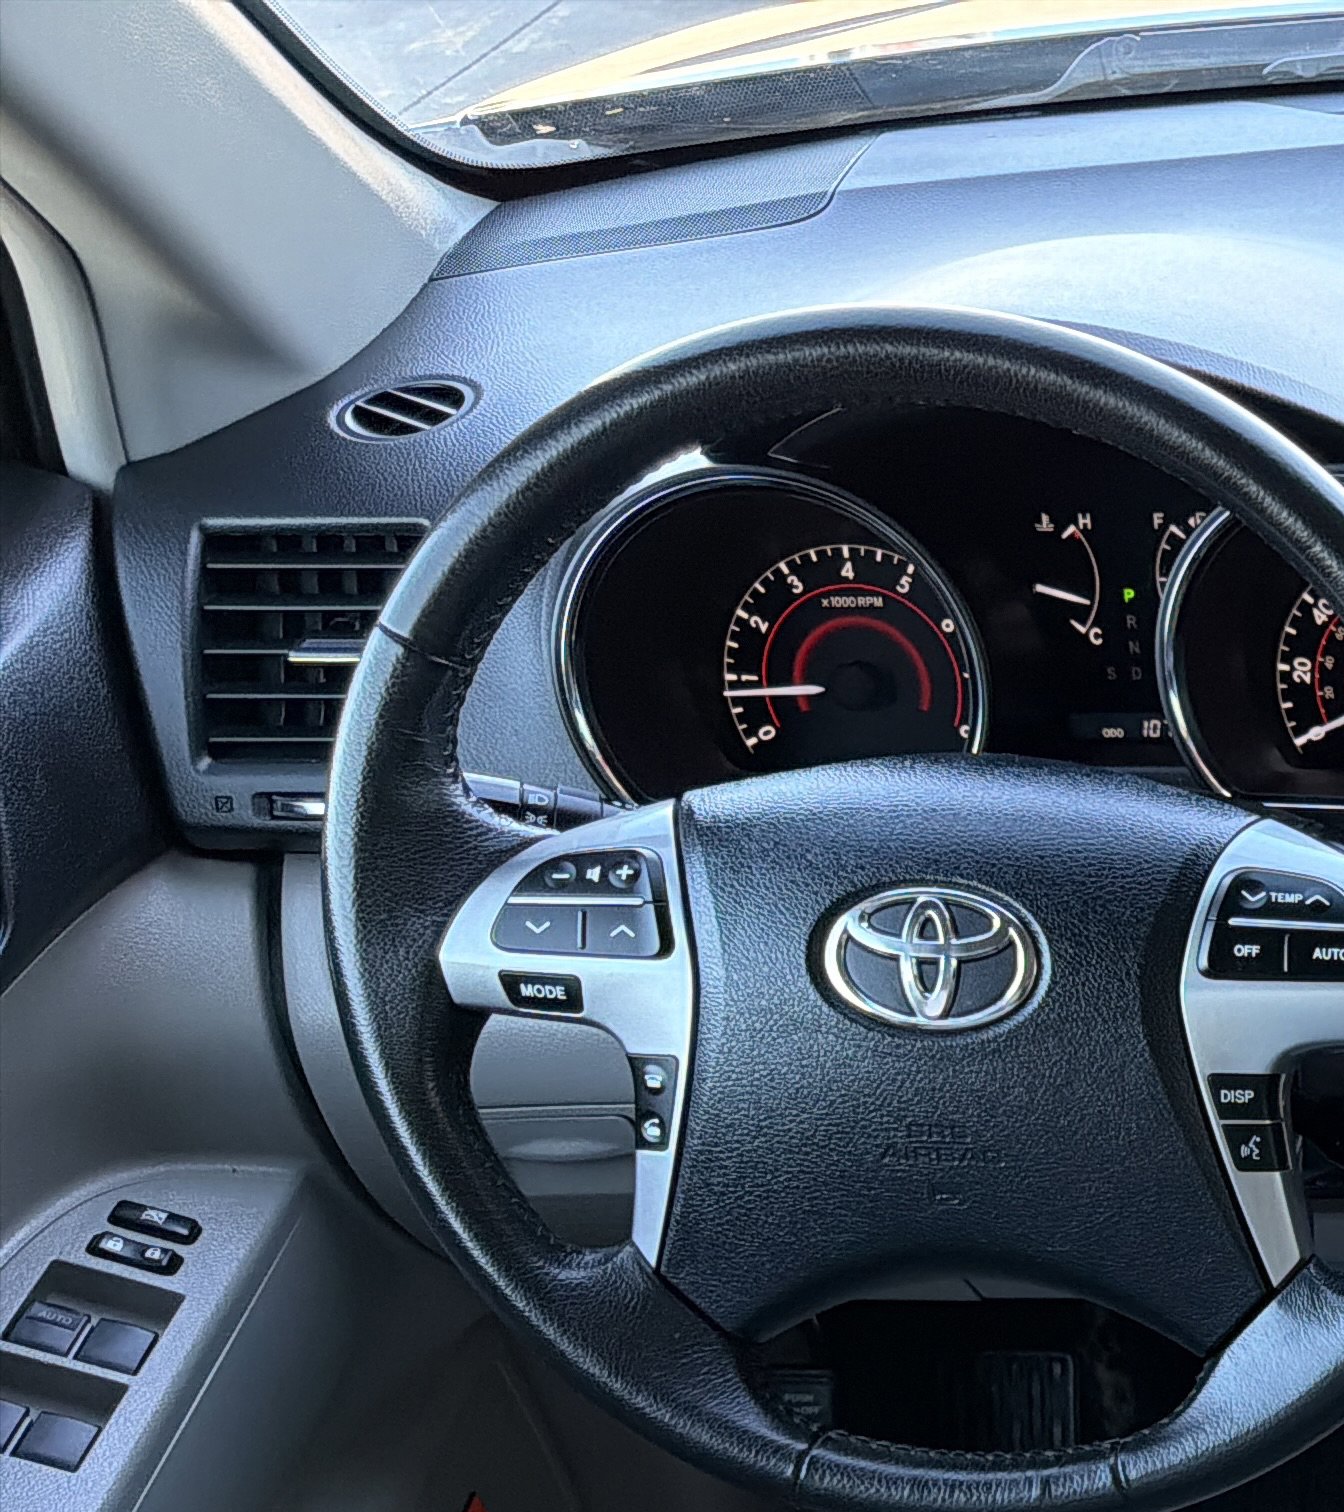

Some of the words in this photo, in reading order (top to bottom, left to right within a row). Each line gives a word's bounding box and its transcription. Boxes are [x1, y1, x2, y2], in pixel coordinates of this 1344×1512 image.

[1078, 512, 1092, 530] H
[1153, 512, 1164, 530] F
[841, 561, 855, 580] 4
[787, 575, 804, 594] 3
[896, 575, 912, 594] 5
[1123, 588, 1134, 602] P
[1126, 615, 1138, 628] R
[1312, 599, 1334, 626] 40
[750, 614, 770, 634] 2
[1088, 627, 1103, 646] C
[1128, 642, 1140, 654] N
[1292, 656, 1312, 686] 20
[758, 725, 776, 740] 0
[1269, 892, 1303, 904] TEMP
[1234, 944, 1260, 957] OFF
[520, 982, 568, 1000] MODE
[1220, 1090, 1254, 1104] DISP
[38, 1309, 73, 1326] AUTO
